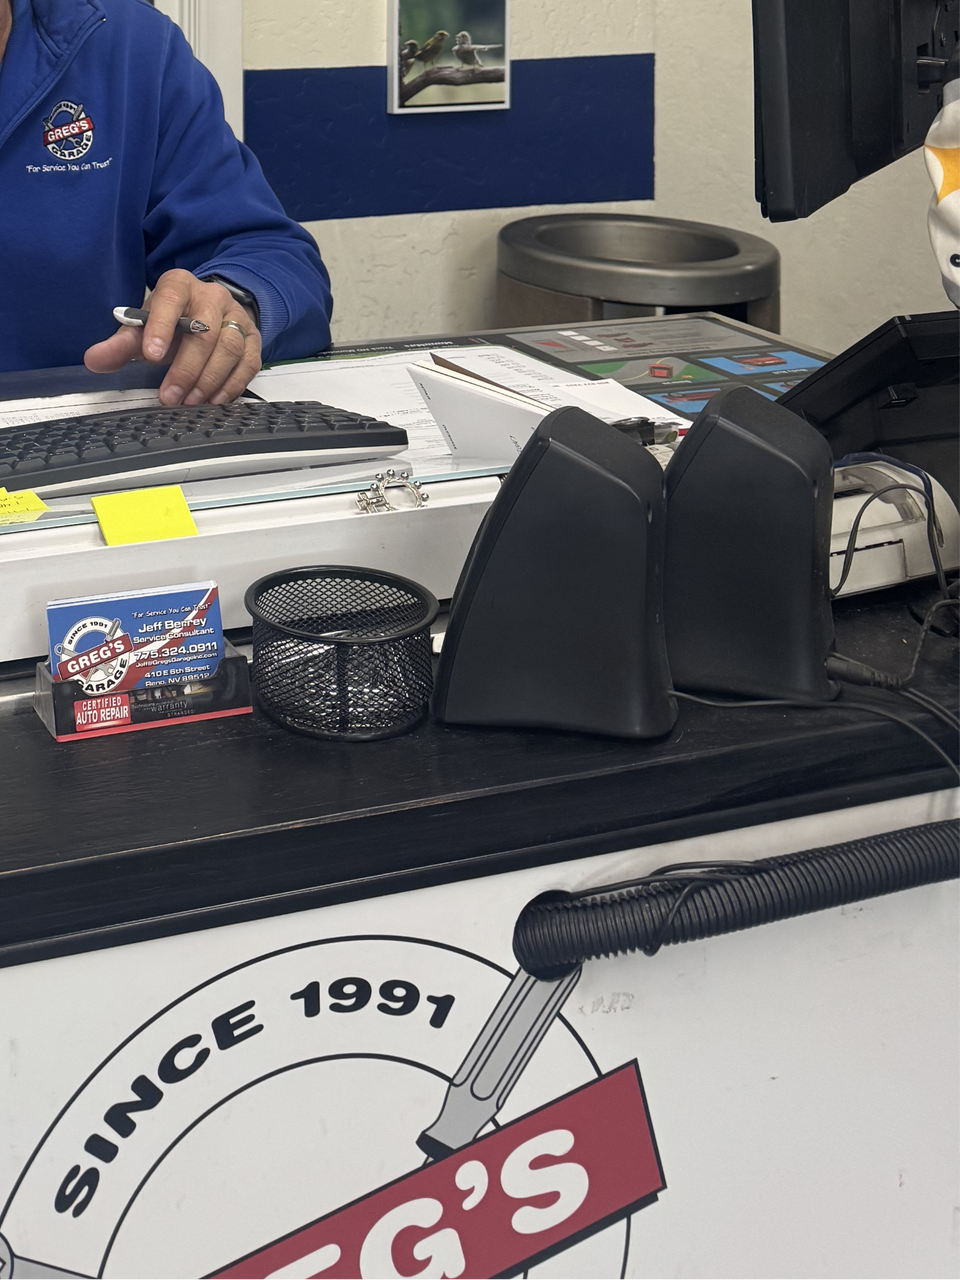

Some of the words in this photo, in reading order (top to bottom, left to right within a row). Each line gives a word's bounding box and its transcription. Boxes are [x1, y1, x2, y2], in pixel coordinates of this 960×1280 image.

[47, 120, 89, 142] GREG'S
[51, 133, 92, 158] GARAGE
[42, 163, 66, 172] Service
[67, 163, 80, 171] You
[68, 623, 88, 646] SINCE
[90, 621, 108, 629] 1991
[132, 635, 166, 644] Service
[166, 627, 215, 639] Consultant
[138, 622, 162, 633] Jeff
[66, 640, 125, 674] GREG'S
[133, 641, 218, 661] 775.324.0911
[144, 670, 163, 678] 410
[184, 664, 210, 673] Street
[182, 672, 210, 682] 89512
[82, 696, 122, 711] CERTIFIED
[150, 701, 188, 712] warranty
[76, 710, 98, 726] AUTO
[100, 705, 129, 720] REPAIR
[52, 999, 266, 1220] SINCE
[289, 976, 457, 1030] 1991
